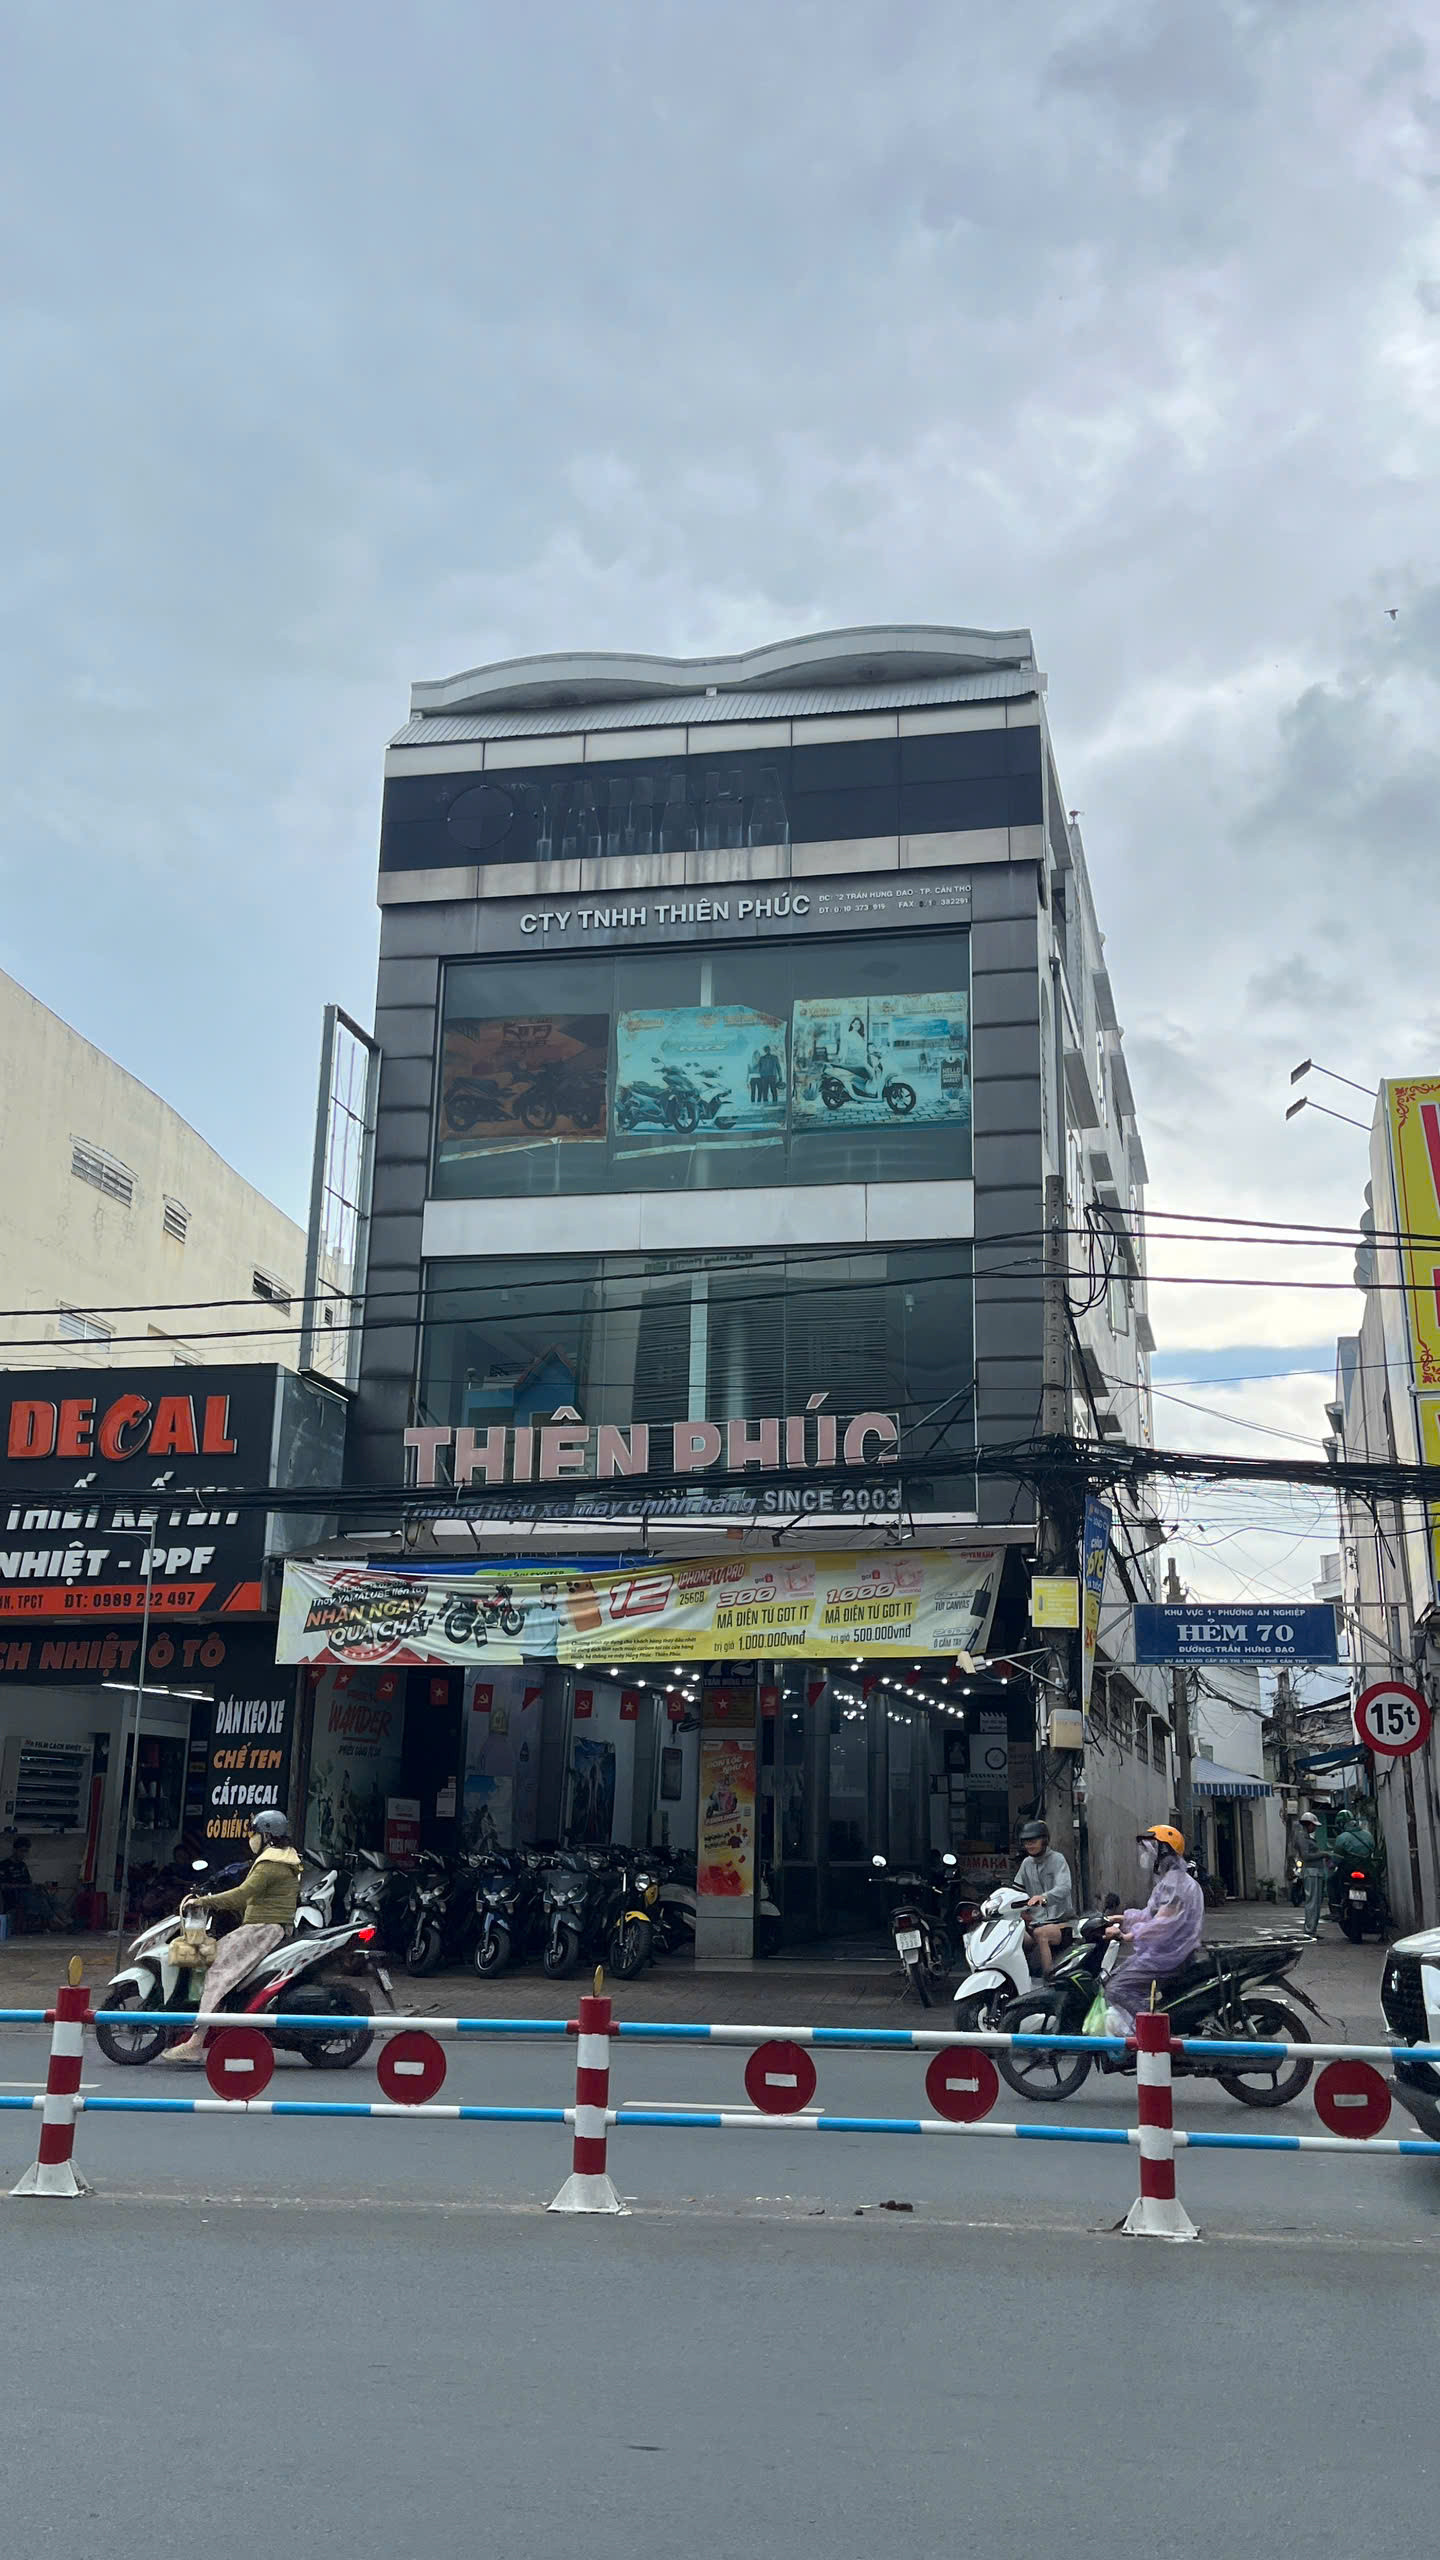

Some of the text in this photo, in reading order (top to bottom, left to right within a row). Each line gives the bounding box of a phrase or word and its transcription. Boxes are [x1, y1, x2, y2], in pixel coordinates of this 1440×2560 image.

[519, 891, 810, 933] CTY TNHH THIÊN PHÚC
[8, 1394, 237, 1462] DECAL
[403, 1392, 899, 1487] THIÊN PHÚC
[762, 1488, 834, 1512] SINCE
[841, 1487, 901, 1511] 2003
[0, 1541, 110, 1586] NHIỆT
[139, 1546, 216, 1576] PPF
[18, 1590, 195, 1609] TPCT ĐT: 0989 222 497
[338, 1588, 390, 1604] YAMALUBE
[609, 1573, 674, 1619] 12
[679, 1591, 705, 1606] 256GB
[717, 1586, 776, 1608] 300
[826, 1582, 896, 1605] 1.000
[369, 1596, 424, 1617] NGAY
[717, 1610, 733, 1629] MÃ
[777, 1606, 797, 1623] GOT
[800, 1605, 809, 1621] IT
[825, 1606, 840, 1624] MÃ
[882, 1602, 901, 1618] GOT
[903, 1602, 912, 1616] IT
[1186, 1609, 1204, 1617] VỰC
[739, 1629, 806, 1651] 1.000.000vnđ
[853, 1624, 911, 1643] 500.000vnđ
[1176, 1618, 1295, 1643] HẺM 70
[39, 1632, 140, 1677] NHIỆT
[148, 1631, 175, 1669] Ô
[215, 1694, 286, 1734] DÁN KEO XE
[213, 1742, 282, 1769] CHẾ TEM
[211, 1777, 279, 1805] CẮT DECAL
[206, 1814, 221, 1839] GÒ
[221, 1810, 243, 1839] BIỂN
